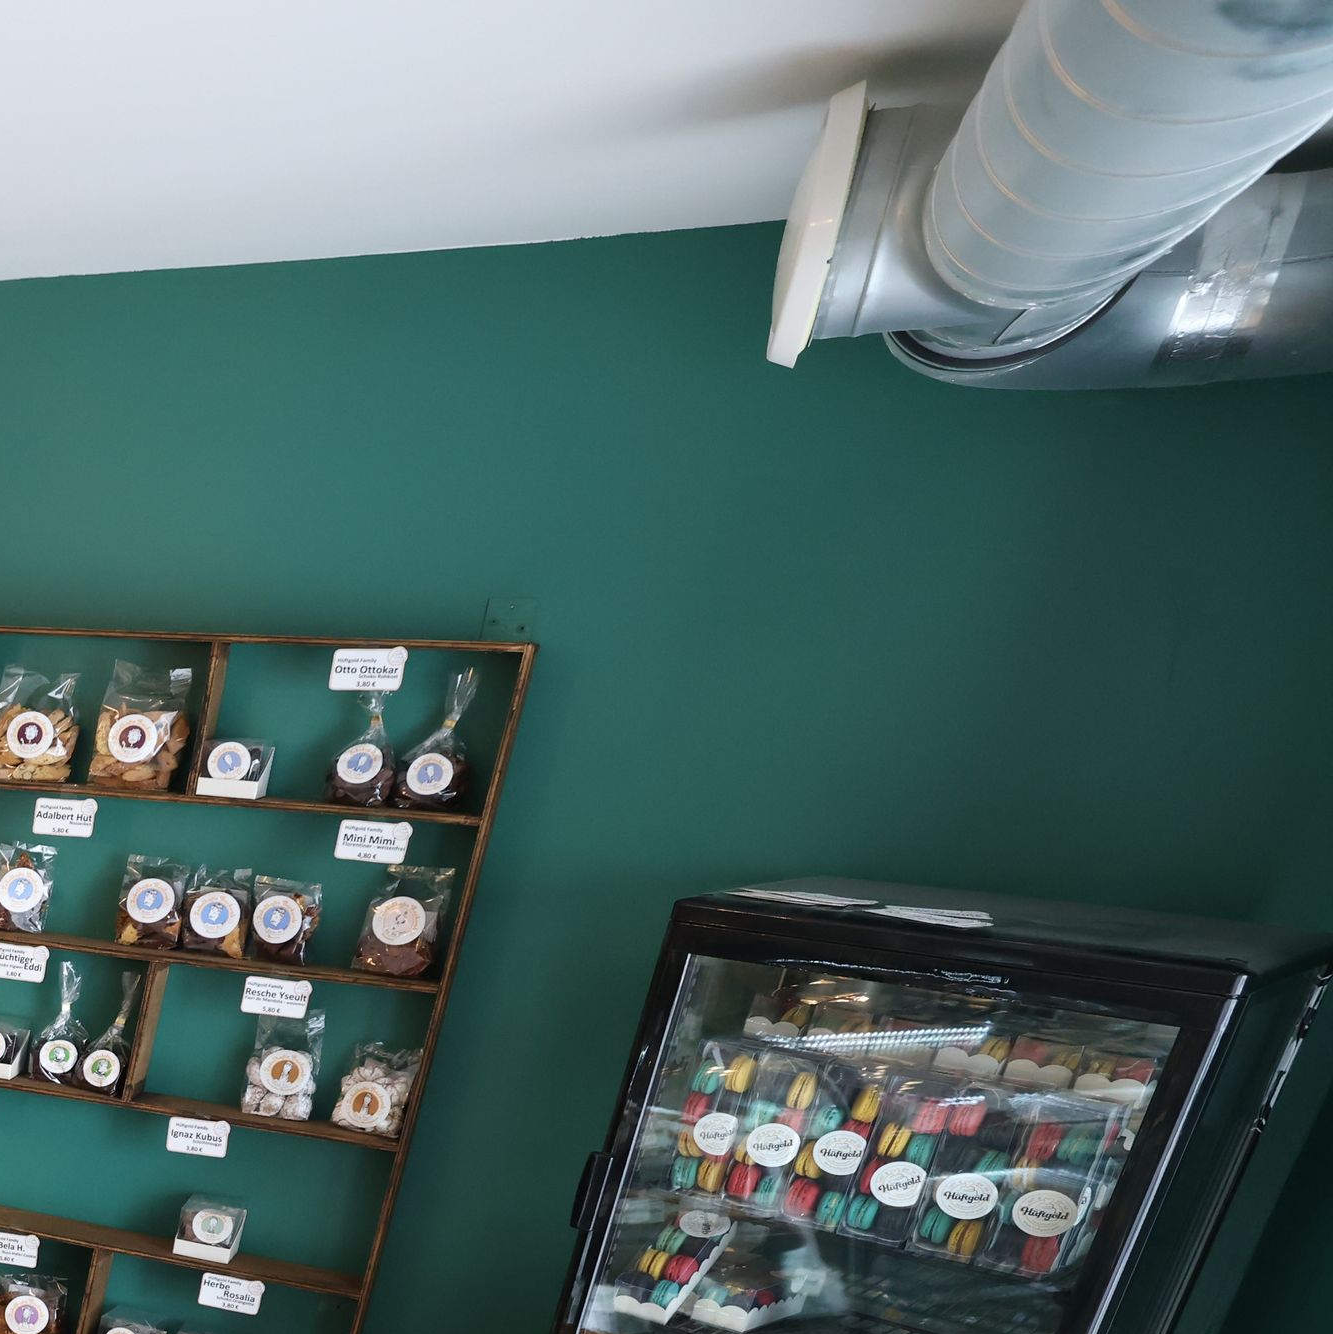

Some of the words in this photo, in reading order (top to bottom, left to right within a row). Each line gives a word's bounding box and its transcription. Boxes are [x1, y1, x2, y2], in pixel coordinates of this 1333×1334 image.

[335, 665, 357, 674] Otto
[359, 665, 399, 674] Ottokar
[36, 810, 74, 820] Adalbert
[76, 814, 92, 822] Hut
[343, 834, 366, 843] Mini
[369, 835, 395, 846] Mimi
[23, 963, 42, 972] Eddi
[245, 988, 277, 998] Resche
[279, 991, 307, 1002] Yseult
[171, 1130, 193, 1140] Ignaz
[195, 1132, 223, 1142] Kubus
[753, 1139, 793, 1153] Hüftgold
[820, 1148, 862, 1161] Hüftgold
[878, 1176, 921, 1193] Hüftgold
[943, 1191, 990, 1204] Hüftgold
[1019, 1206, 1069, 1221] Hüftgold
[17, 1244, 25, 1252] H.
[203, 1279, 231, 1291] Herbe
[223, 1290, 255, 1303] Rosalia
